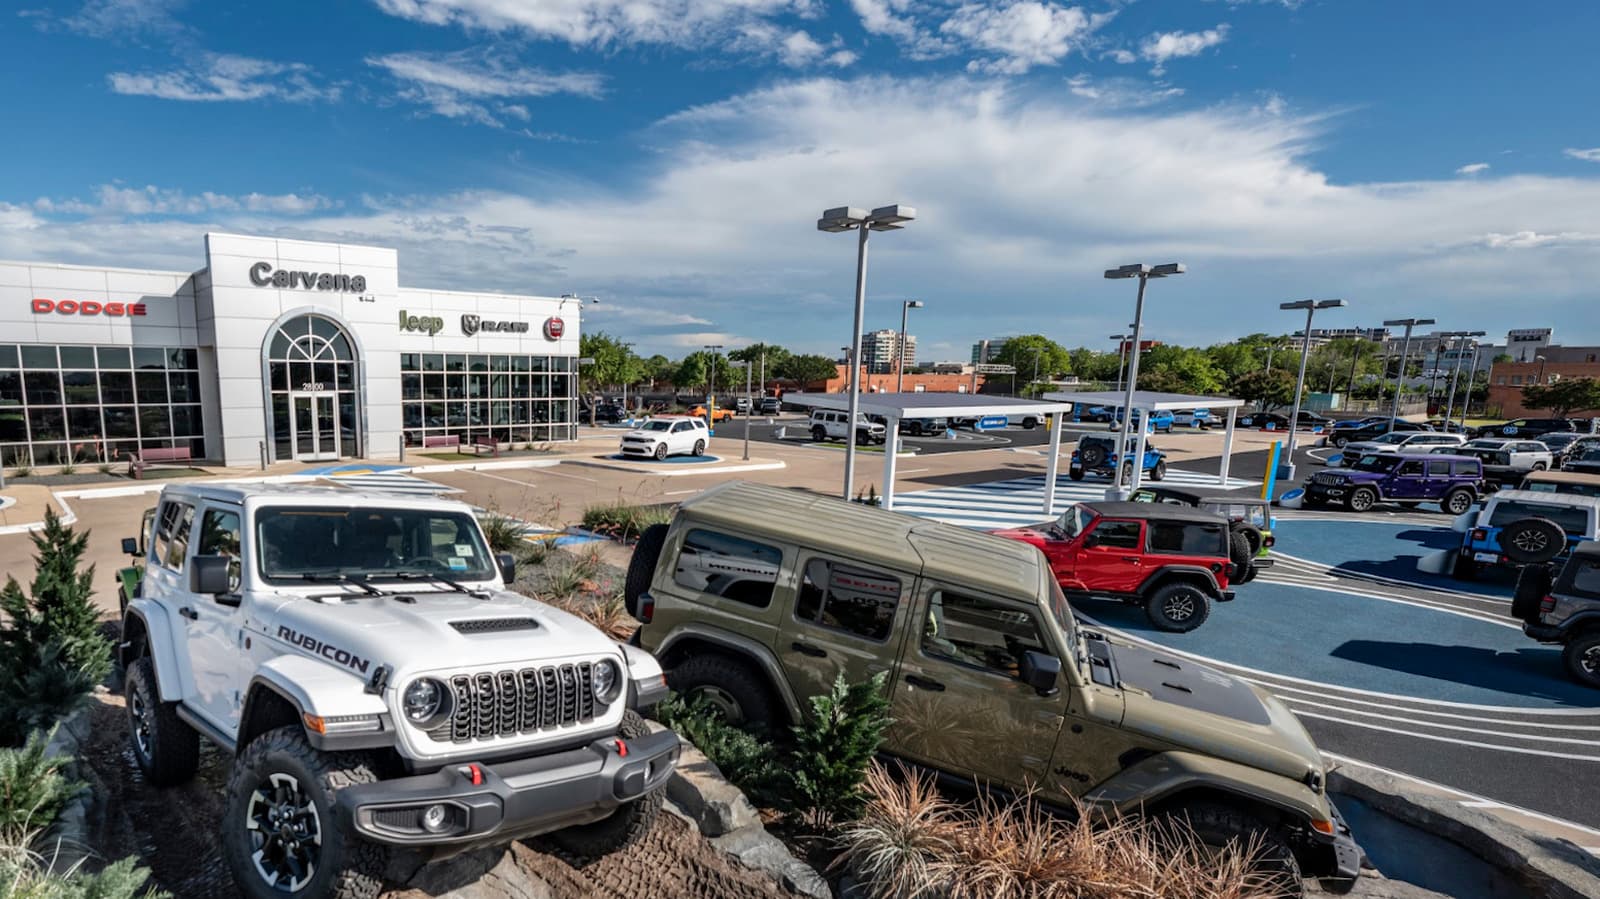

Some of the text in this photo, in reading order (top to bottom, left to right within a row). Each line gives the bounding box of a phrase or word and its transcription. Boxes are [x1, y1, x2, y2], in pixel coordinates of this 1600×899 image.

[249, 261, 367, 292] Carvana
[31, 299, 147, 316] DODGE
[399, 310, 444, 336] Jeep
[481, 320, 529, 333] RAM
[277, 625, 370, 674] RUBICON
